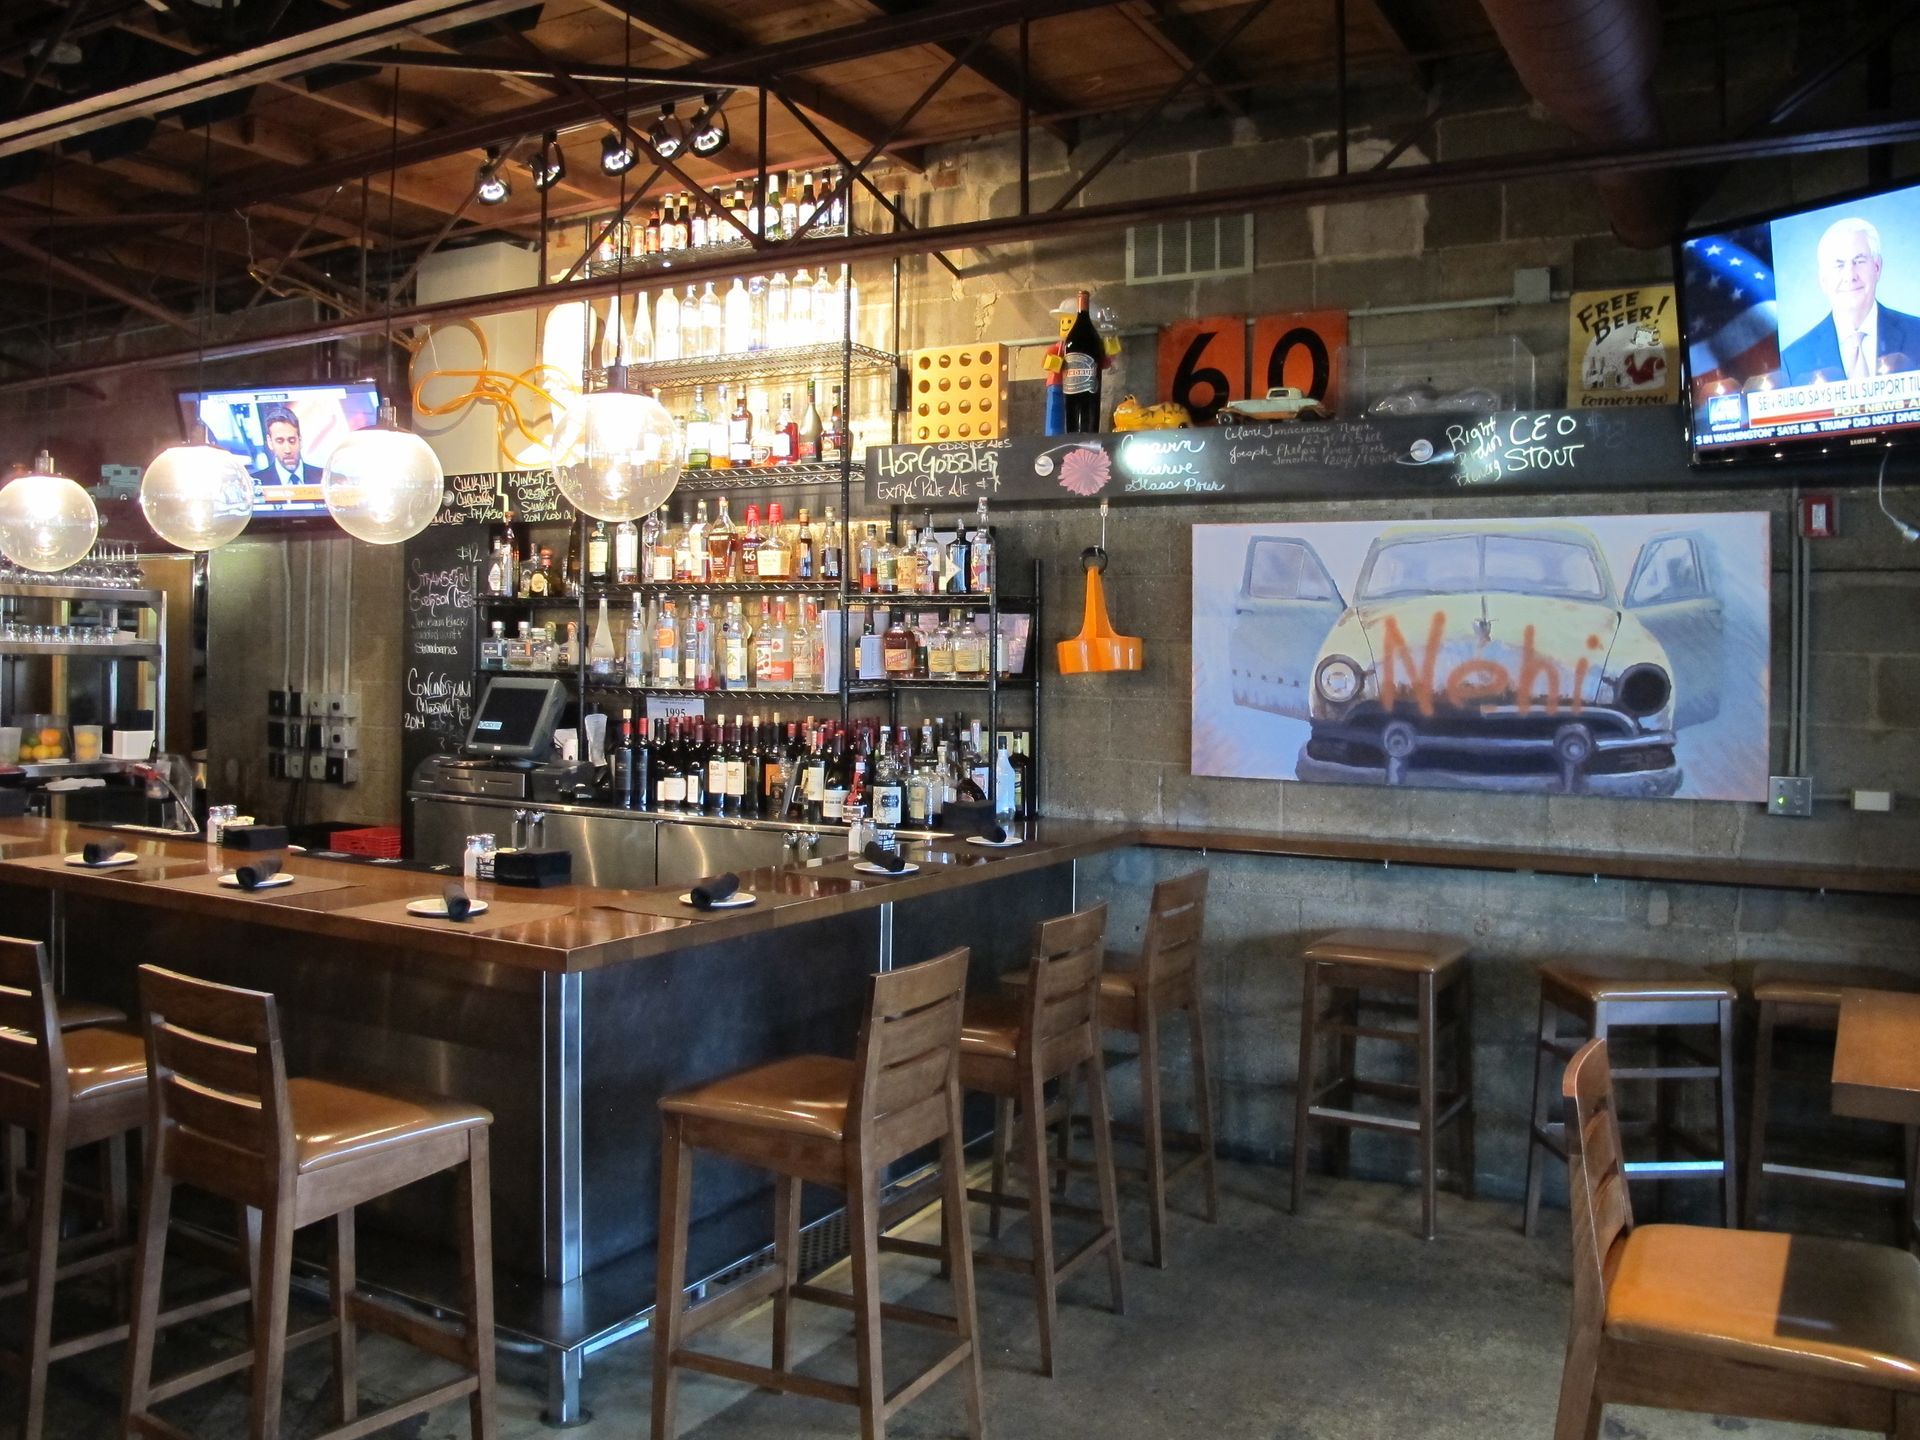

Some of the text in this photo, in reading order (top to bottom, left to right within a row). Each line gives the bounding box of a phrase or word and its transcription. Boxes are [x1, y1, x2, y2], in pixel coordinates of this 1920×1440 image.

[1577, 292, 1639, 333] FREE
[1592, 296, 1670, 346] BEER!
[1778, 391, 1805, 407] RUBIO
[1809, 387, 1831, 404] SAYS
[1862, 378, 1905, 398] SUPPORT
[1834, 405, 1862, 417] FOX
[1864, 400, 1905, 413] NEWS
[1509, 414, 1577, 445] CEO
[1777, 424, 1799, 436] SAYS
[1819, 418, 1852, 432] TRUMP
[1853, 416, 1871, 428] DID
[1872, 414, 1894, 426] NOT
[1504, 444, 1584, 471] STOUT
[742, 550, 757, 563] 46
[1378, 610, 1604, 716] Nehi
[665, 707, 686, 717] 1995
